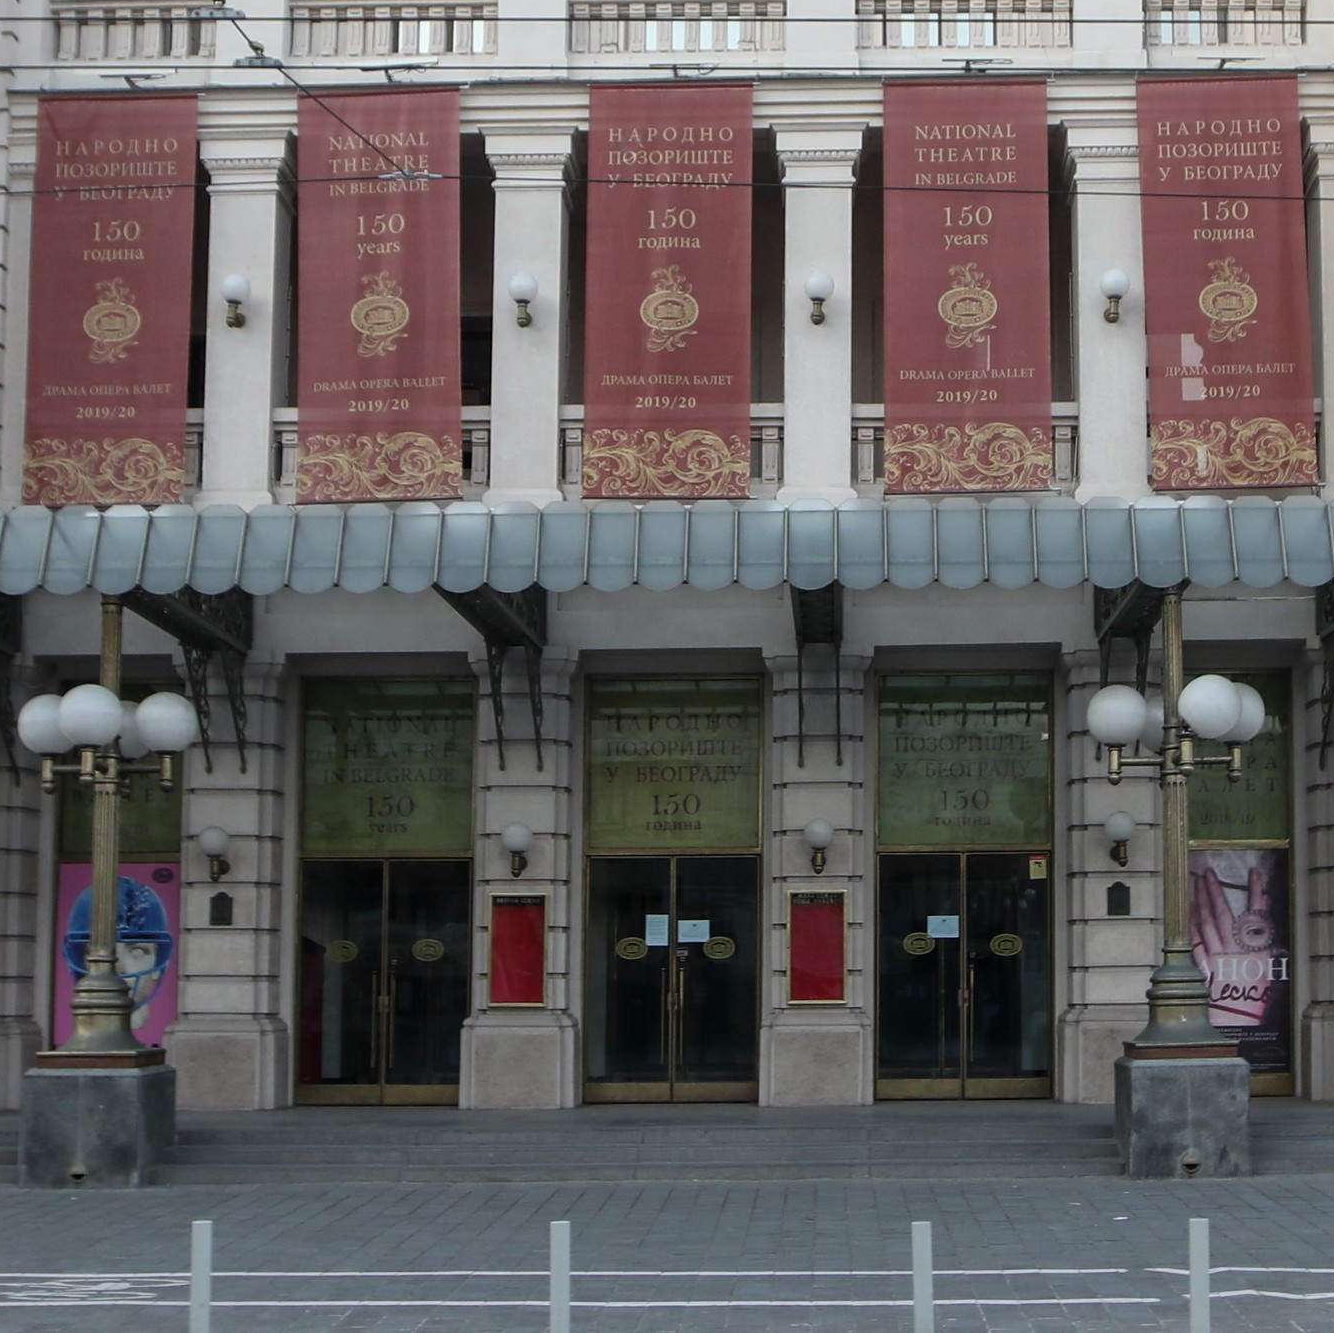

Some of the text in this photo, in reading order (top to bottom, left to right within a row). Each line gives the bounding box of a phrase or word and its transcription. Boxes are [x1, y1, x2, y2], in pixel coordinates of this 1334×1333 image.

[608, 127, 733, 143] НАРОДНО
[915, 124, 1016, 139] NATIONAL
[1157, 118, 1281, 136] НАРОДНО
[56, 138, 178, 156] НАРОДНО
[329, 132, 429, 151] NATIONAL
[1158, 141, 1282, 159] ПОЗОРИШТЕ
[608, 150, 733, 165] ПОЗОРИШТЕ
[914, 146, 1016, 163] THEATRE
[55, 161, 177, 178] ПОЗОРИШТЕ
[329, 154, 429, 173] THEATRE
[1158, 163, 1283, 181] У БЕОГРАДУ
[608, 173, 733, 190] У БЕОГРАДУ
[915, 171, 1017, 185] IN BELGRADE
[55, 184, 177, 201] У БЕОГРАДУ
[329, 180, 429, 196] IN BELGRADE
[648, 207, 696, 230] 150
[943, 205, 993, 227] 150
[1201, 200, 1249, 221] 150
[93, 220, 140, 242] 150
[357, 213, 405, 235] 150
[638, 236, 700, 250] година
[944, 233, 988, 250] years
[1193, 227, 1255, 242] година
[83, 248, 144, 262] година
[357, 241, 401, 259] years
[900, 368, 1035, 380] DRAMA OPERA BALLET
[1165, 363, 1296, 377] ДРАМА ОПЕРА БАЛЕТ
[313, 376, 446, 392] DRAMA OPERA BALLET
[601, 375, 734, 386] ДРАМА ОПЕРА БАЛЕТ
[42, 383, 172, 396] ДРАМА ОПЕРА БАЛЕТ
[936, 390, 998, 403] 2019/20
[1200, 385, 1261, 398] 2019/20
[348, 398, 409, 412] 2019/20
[635, 396, 697, 410] 2019/20
[76, 406, 135, 419] 2019/20
[606, 714, 742, 731] НАРОДНО
[607, 740, 741, 757] ПОЗОРИШТЕ
[895, 735, 1031, 752] ПОЗОРИШТЕ
[324, 767, 455, 784] IN BELGRADE
[606, 766, 742, 784] У БЕОГРАДУ
[1198, 777, 1278, 793] АЛЕТ
[367, 793, 415, 818] 150
[652, 793, 700, 815] 150
[940, 788, 990, 811] 150
[369, 822, 408, 837] years
[646, 820, 701, 831] година
[1199, 957, 1289, 982] АНОН
